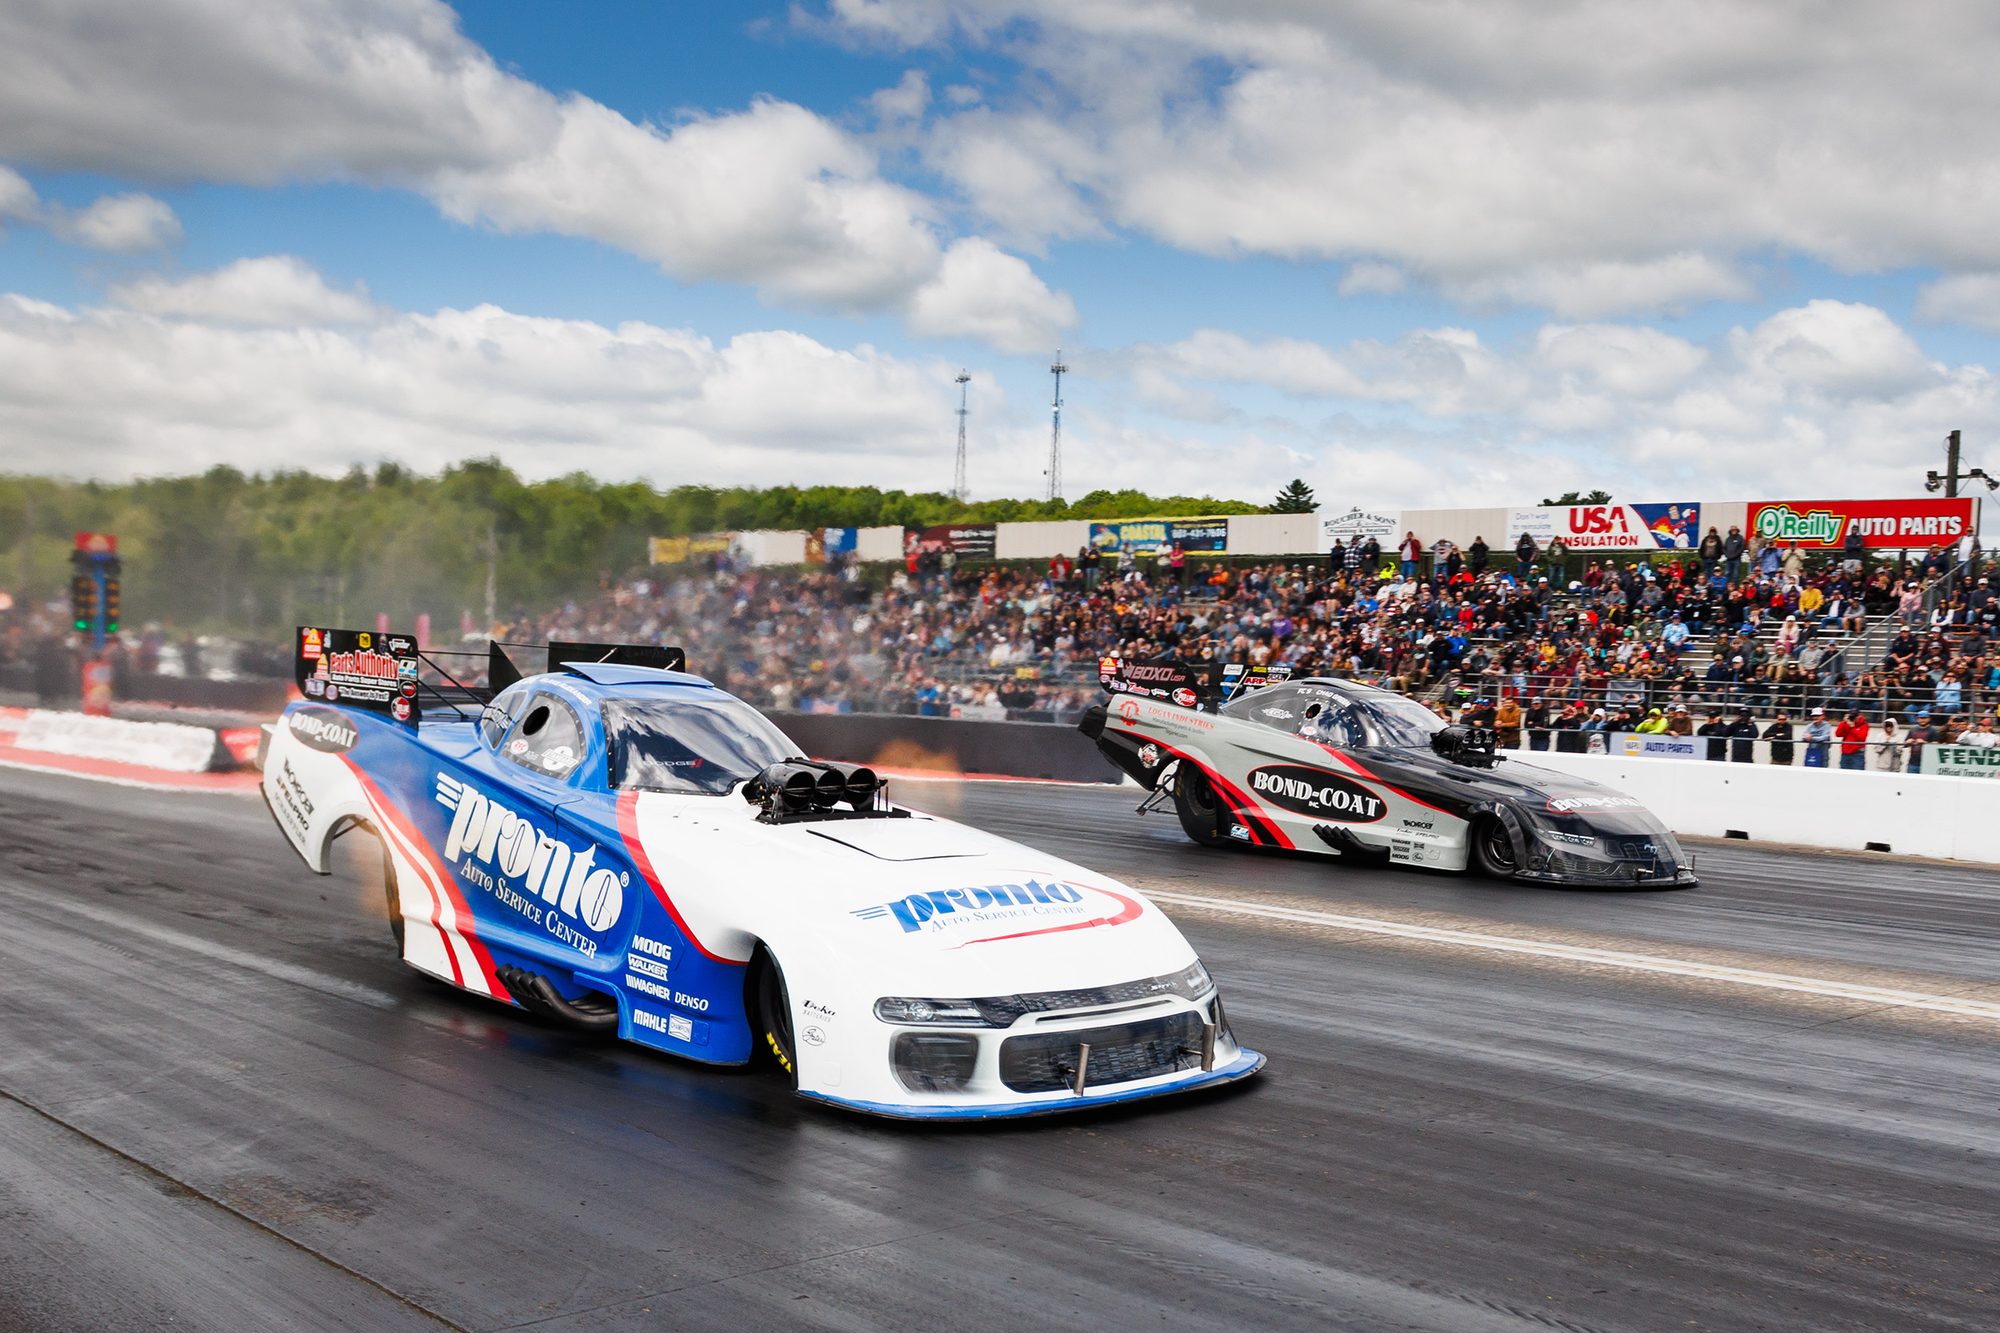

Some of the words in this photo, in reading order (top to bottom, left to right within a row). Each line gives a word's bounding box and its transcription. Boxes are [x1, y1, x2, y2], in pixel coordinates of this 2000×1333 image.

[1374, 515, 1397, 525] SONS
[1569, 507, 1629, 534] USA
[1758, 509, 1840, 541] O'Reilly
[1846, 517, 1896, 536] AUTO
[1899, 516, 1962, 536] PARTS
[330, 651, 354, 674] Parts
[355, 648, 399, 679] Authority
[1131, 666, 1175, 682] BOXO
[1645, 741, 1666, 752] AUTO
[1667, 742, 1695, 754] PARTS
[1937, 767, 1961, 776] Official
[1963, 768, 1987, 778] Tractor
[1253, 771, 1380, 817] BOND-COAT
[444, 783, 623, 932] pronto
[887, 879, 1084, 934] pronto
[931, 916, 970, 932] AUTO
[973, 909, 1031, 921] SERVICE
[1033, 905, 1085, 915] CENTER
[631, 934, 672, 961] MOOG
[628, 955, 668, 982] WALKER
[632, 975, 671, 1001] WAGNER
[674, 991, 709, 1011] DENSO
[633, 1009, 668, 1034] MAHLE
